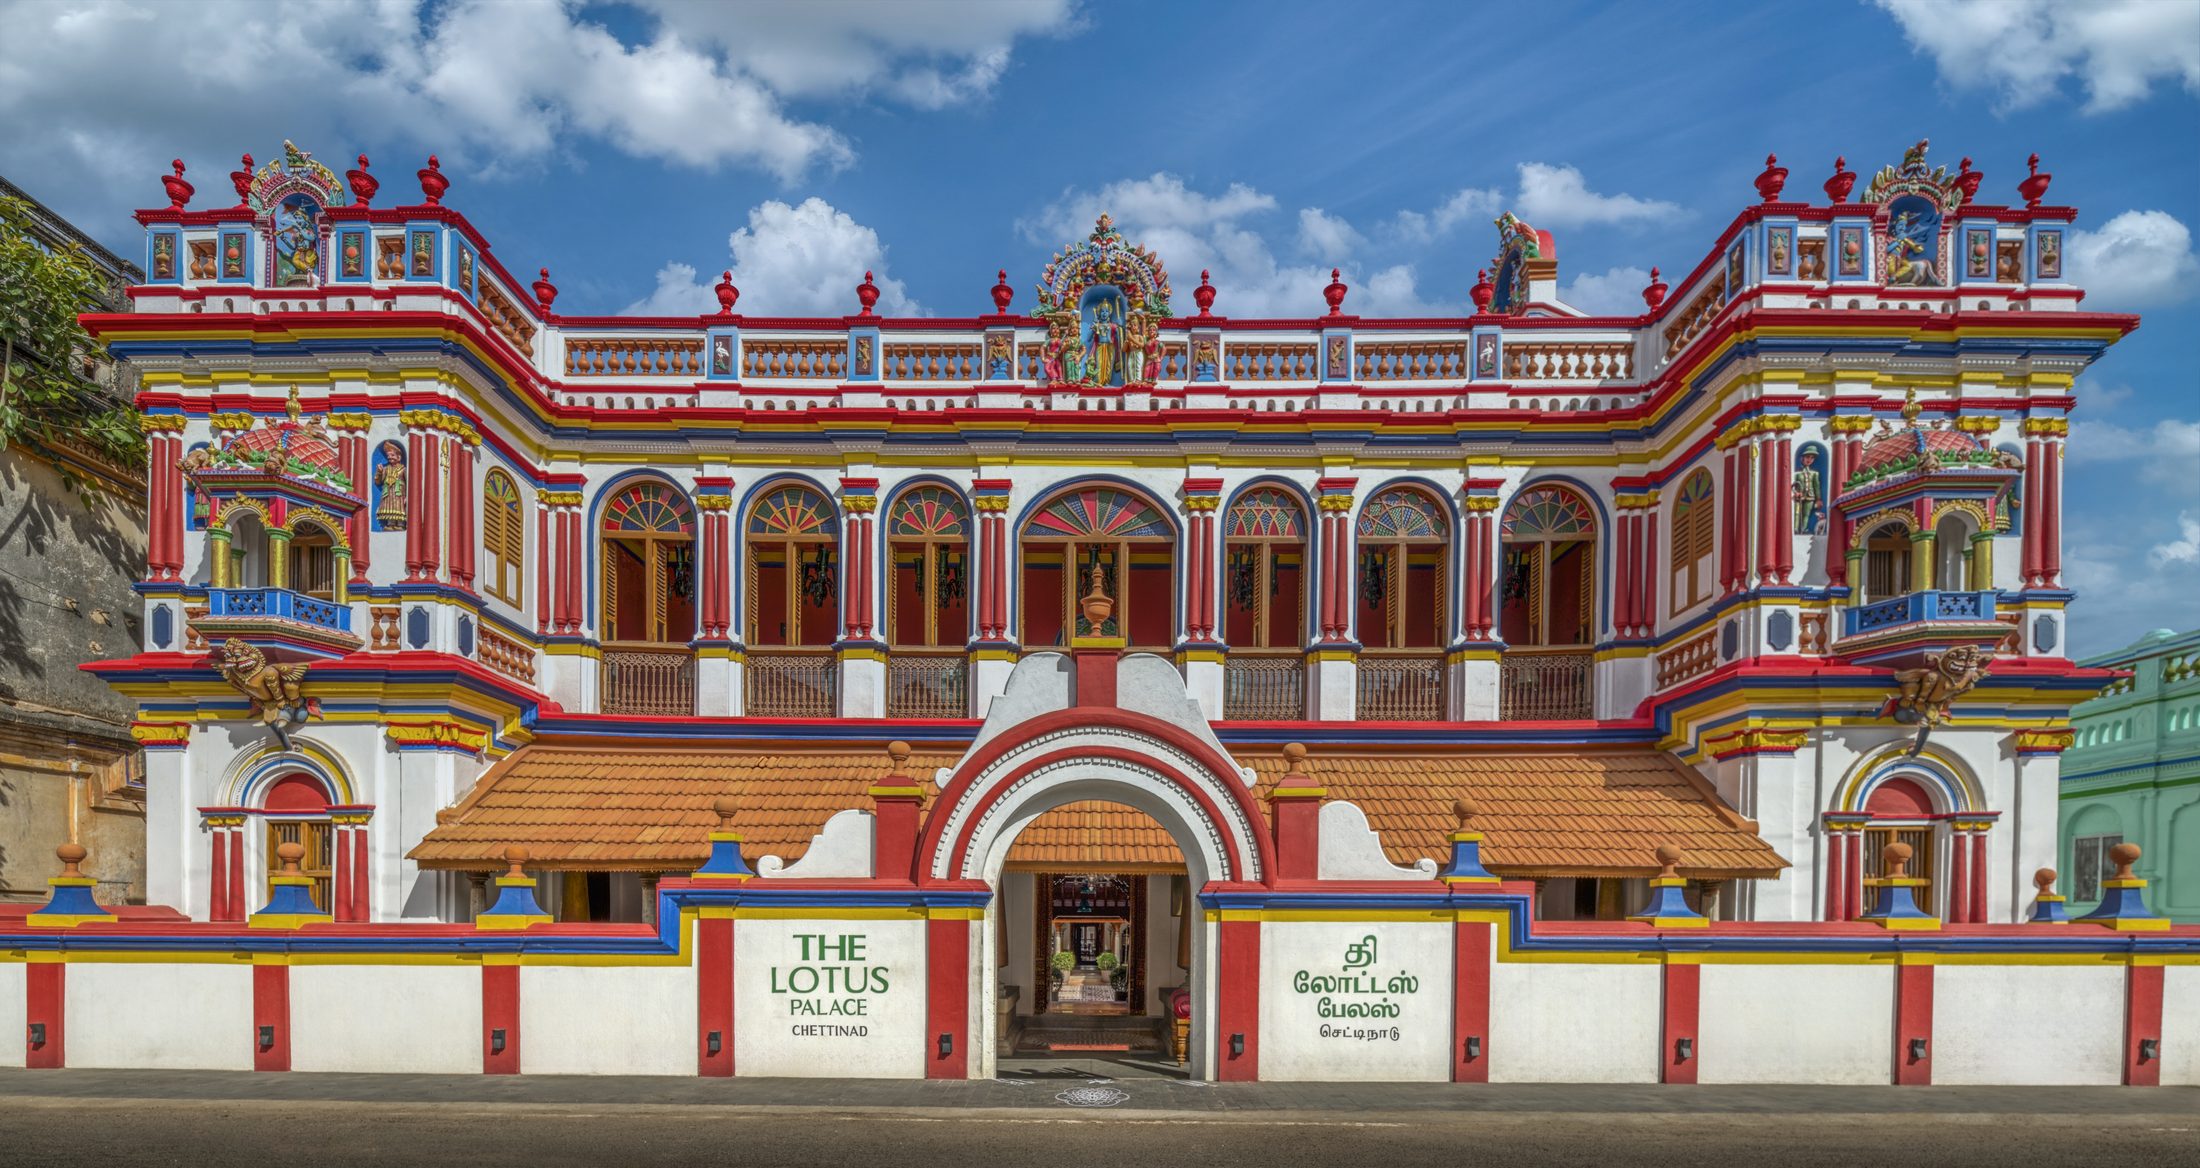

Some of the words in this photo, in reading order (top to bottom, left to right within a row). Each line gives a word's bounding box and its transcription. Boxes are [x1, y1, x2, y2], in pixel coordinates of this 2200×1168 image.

[793, 934, 867, 961] THE
[1342, 934, 1377, 972] தி
[771, 966, 890, 994] LOTUS
[1294, 970, 1419, 994] லோட்டஸ்
[790, 999, 868, 1016] PALACE
[1317, 997, 1400, 1018] பேலஸ்
[792, 1025, 868, 1037] CHETTINAD
[1319, 1024, 1400, 1041] செட்டிநாடு
